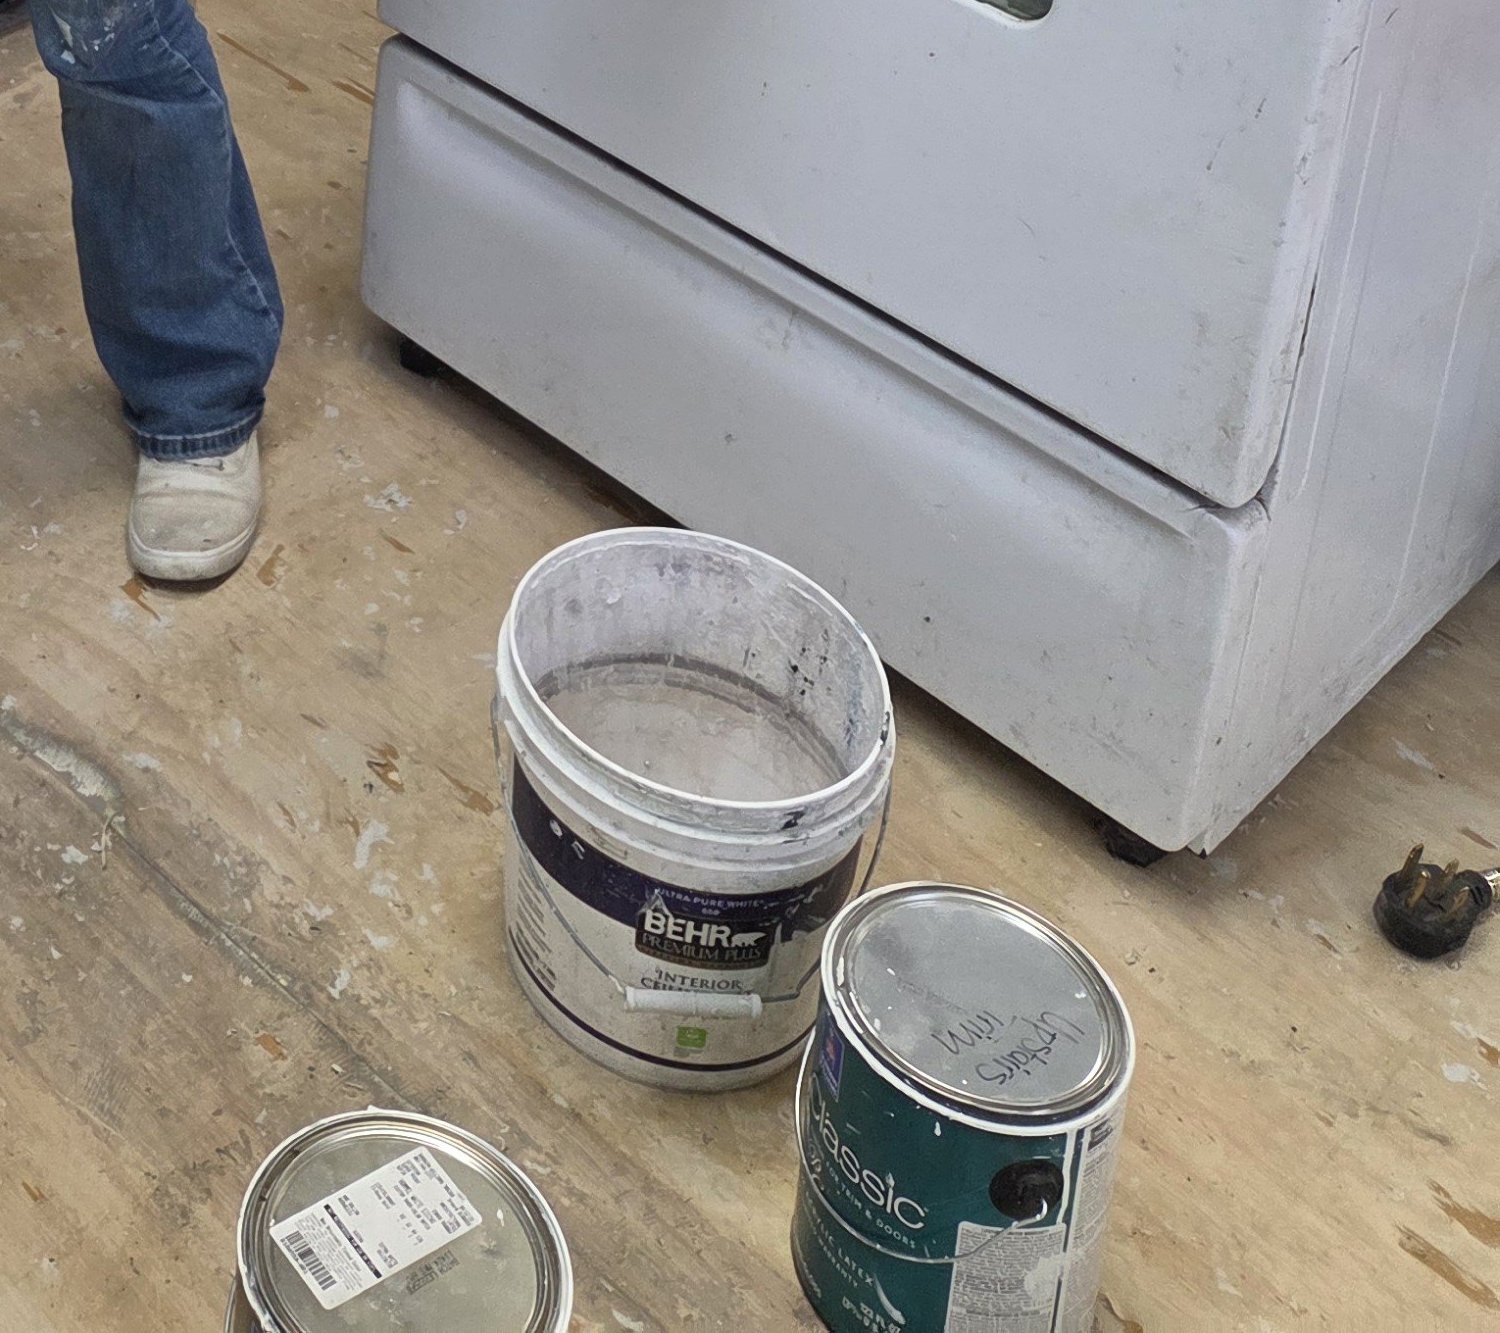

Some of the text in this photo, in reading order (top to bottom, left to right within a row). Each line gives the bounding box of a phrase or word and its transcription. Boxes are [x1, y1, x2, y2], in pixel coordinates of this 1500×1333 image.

[657, 888, 691, 904] ULTRA
[693, 895, 725, 909] PURE
[642, 933, 762, 962] PREMIUM PLUS
[643, 908, 732, 949] BEHR
[657, 967, 744, 991] INTERIOR
[810, 1071, 926, 1230] Classic
[840, 1183, 863, 1210] TRIM
[875, 1217, 916, 1250] DOORS
[837, 1246, 874, 1287] LATEX
